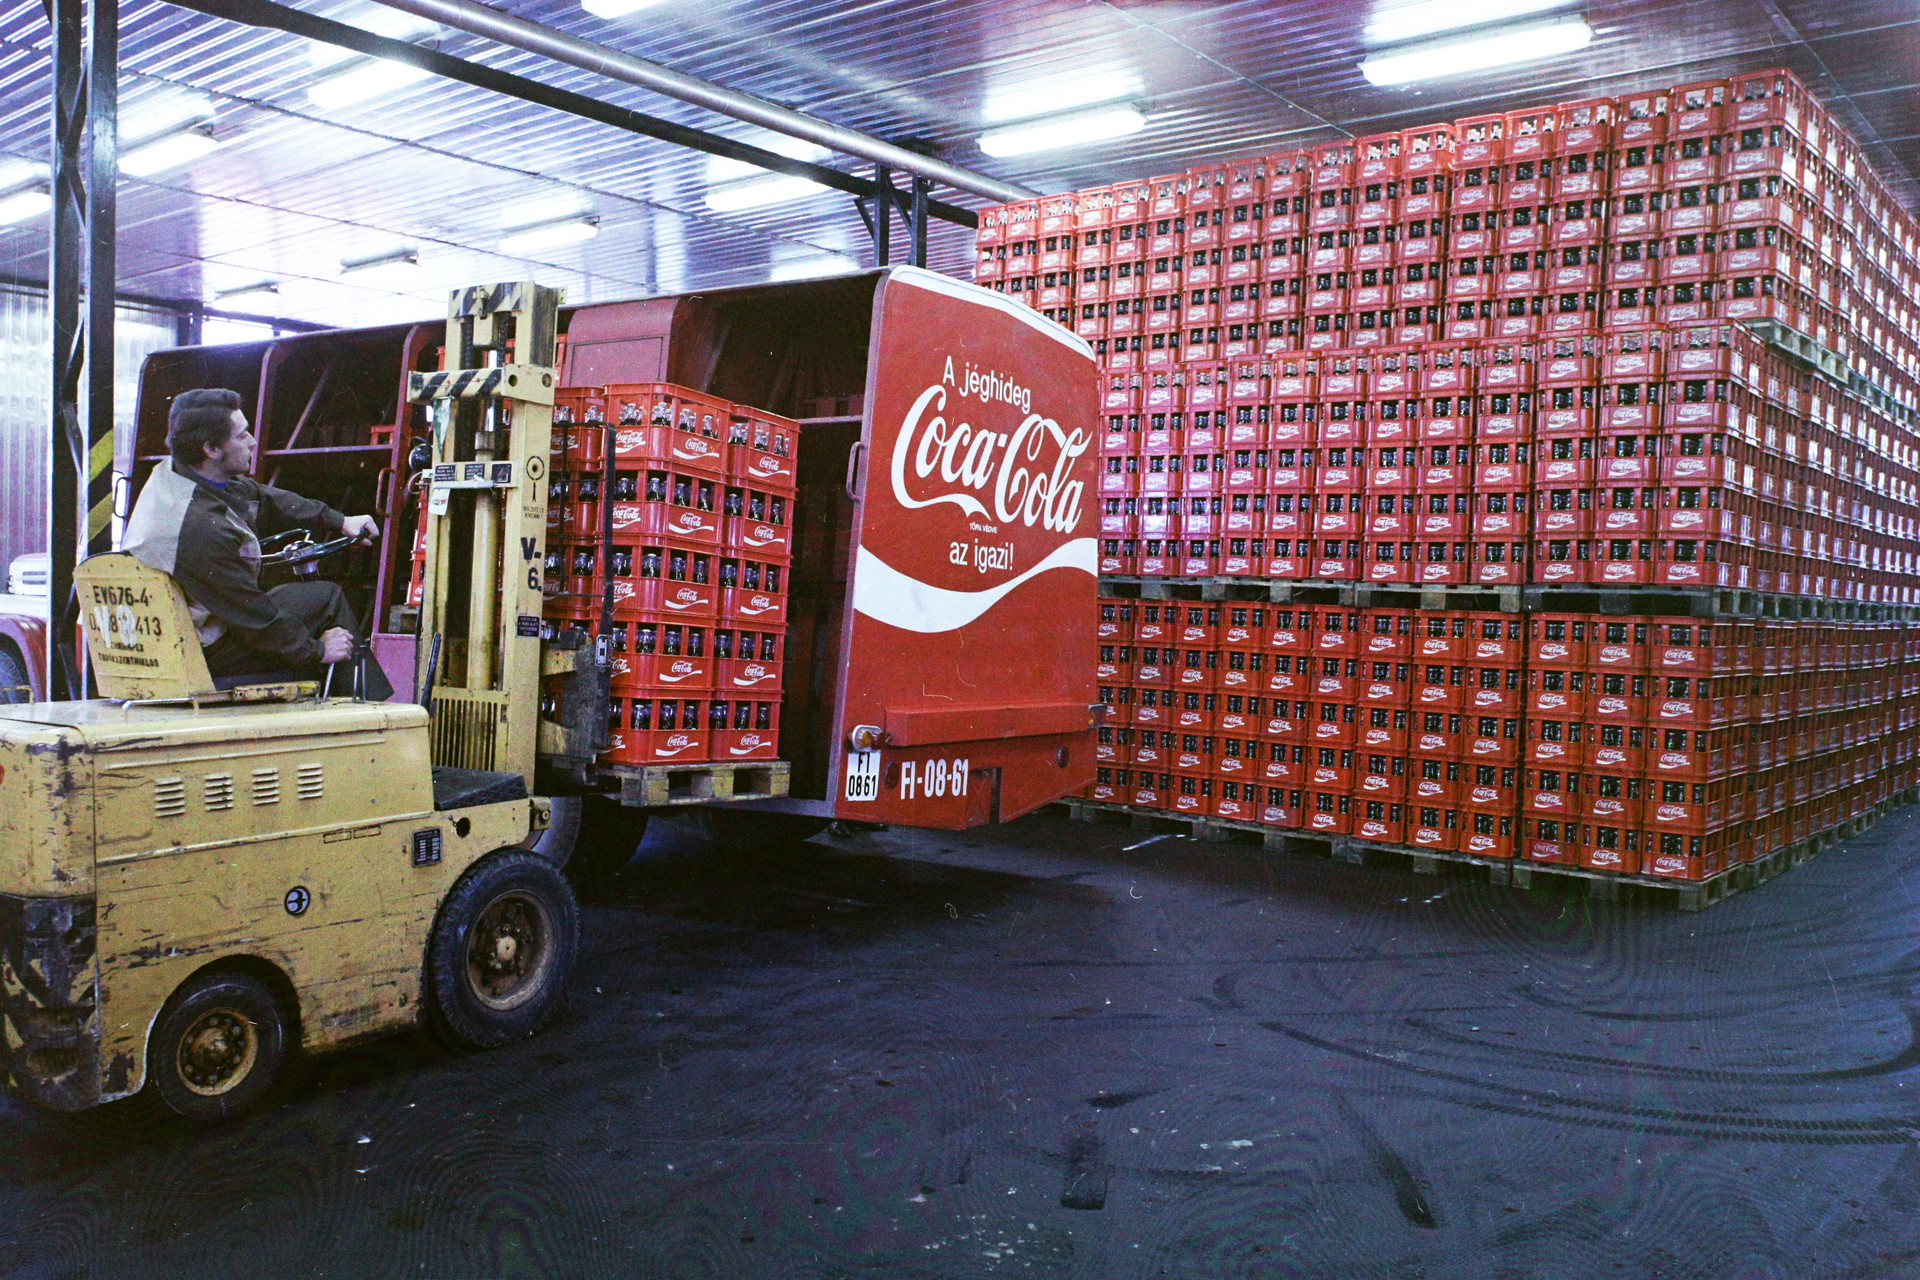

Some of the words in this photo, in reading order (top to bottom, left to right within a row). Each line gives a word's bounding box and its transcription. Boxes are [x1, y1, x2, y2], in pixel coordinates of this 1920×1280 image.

[942, 356, 955, 386] A
[959, 362, 1031, 413] jéghideg
[685, 437, 708, 453] Coca-Cola
[759, 457, 780, 471] Coca-Cola
[891, 384, 1092, 534] Coca-Cola
[680, 513, 702, 527] Coca-Cola
[754, 526, 774, 540] Coca-Cola
[949, 541, 969, 566] az
[974, 538, 1014, 573] igazi!
[677, 588, 698, 602] Coca-Cola
[751, 595, 770, 608] Coca-Cola
[671, 661, 693, 673] Coca-Cola
[744, 665, 765, 677] Coca-Cola
[667, 735, 688, 747] Coca-Cola
[740, 735, 760, 746] Coca-Cola
[900, 758, 969, 800] FI-08-61
